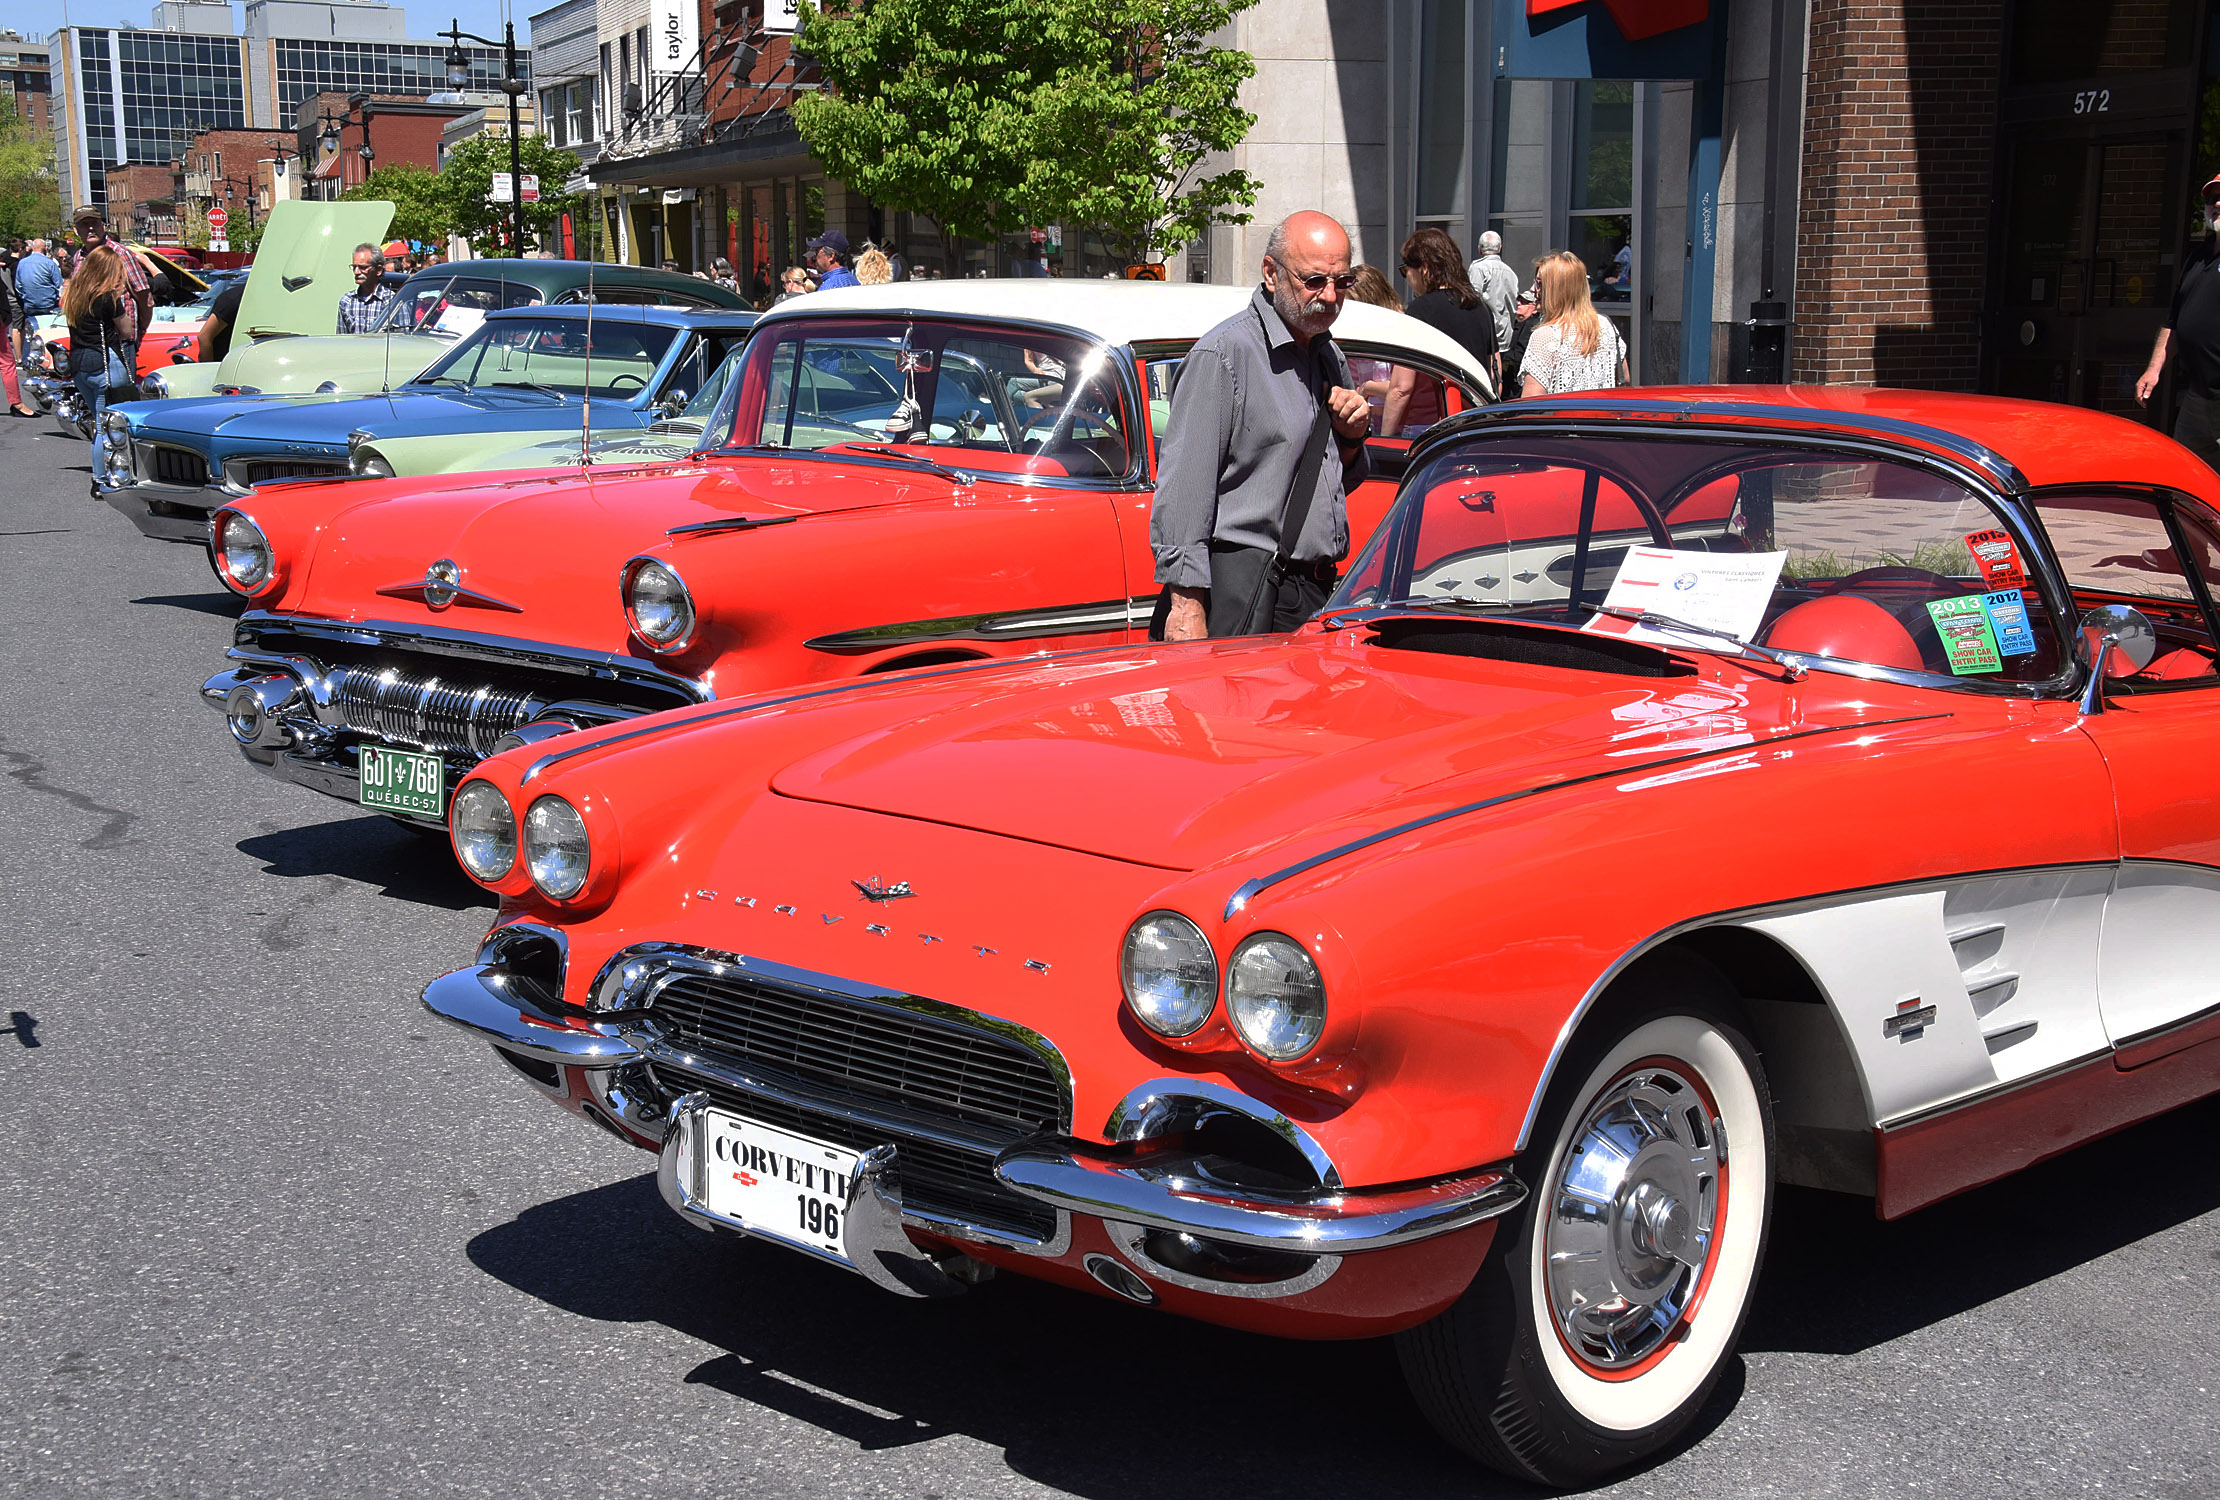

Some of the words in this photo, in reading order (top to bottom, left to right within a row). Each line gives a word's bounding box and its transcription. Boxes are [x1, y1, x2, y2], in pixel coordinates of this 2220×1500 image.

[665, 12, 683, 61] taylor
[2073, 89, 2110, 114] 572
[209, 213, 227, 221] ARRÊT
[283, 445, 338, 455] PONTIAC
[1986, 591, 2020, 605] 2012
[1930, 597, 1981, 615] 2013
[1940, 616, 1983, 627] DAYTONA
[1952, 649, 1976, 658] SHOW
[1976, 648, 1992, 656] CAR
[2001, 642, 2018, 650] ENTRY
[1951, 657, 1977, 666] ENTRY
[1978, 656, 1997, 664] PASS
[364, 751, 393, 788] 601
[406, 757, 438, 795] 768
[696, 889, 1052, 976] CORVETTE
[797, 1193, 845, 1240] 196
